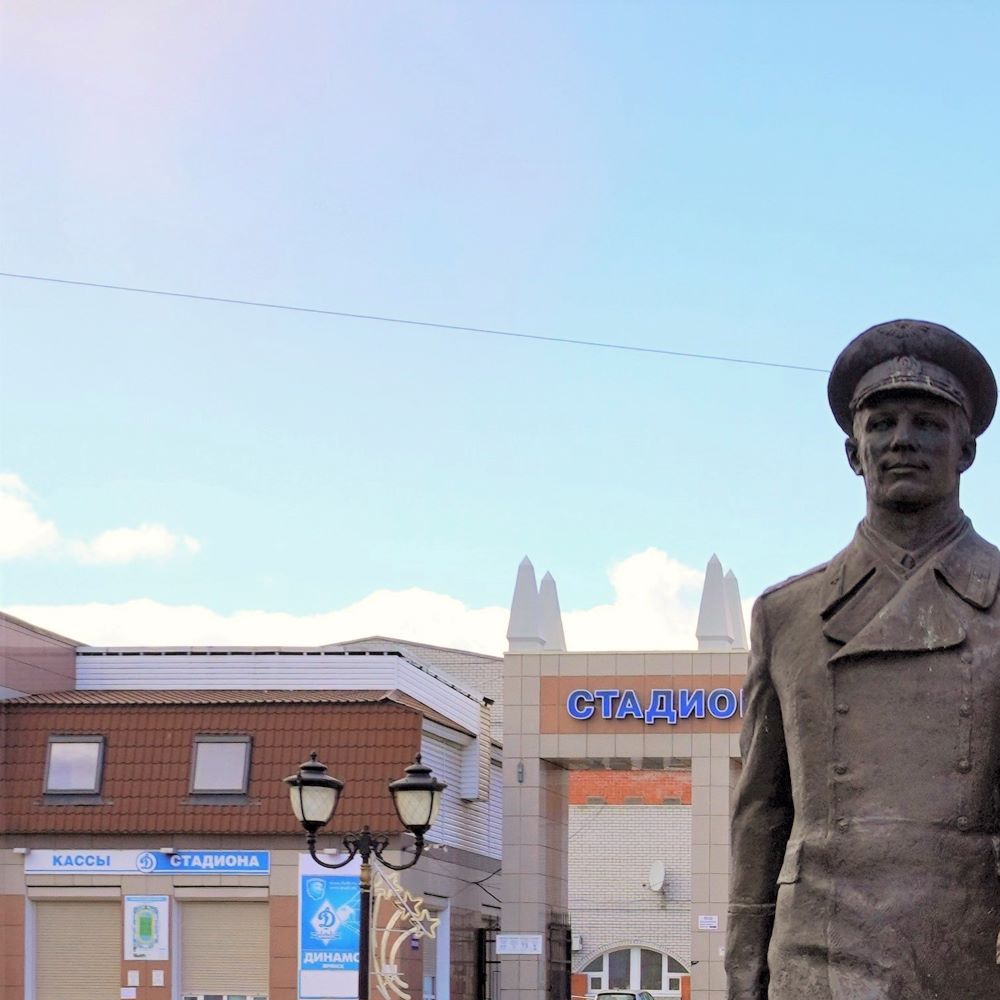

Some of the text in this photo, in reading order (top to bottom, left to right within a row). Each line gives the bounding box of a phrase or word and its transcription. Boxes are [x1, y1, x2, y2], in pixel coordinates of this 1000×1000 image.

[567, 688, 743, 724] СТАДИО
[52, 855, 110, 866] КАССЫ
[170, 854, 260, 869] СТАДИОНА
